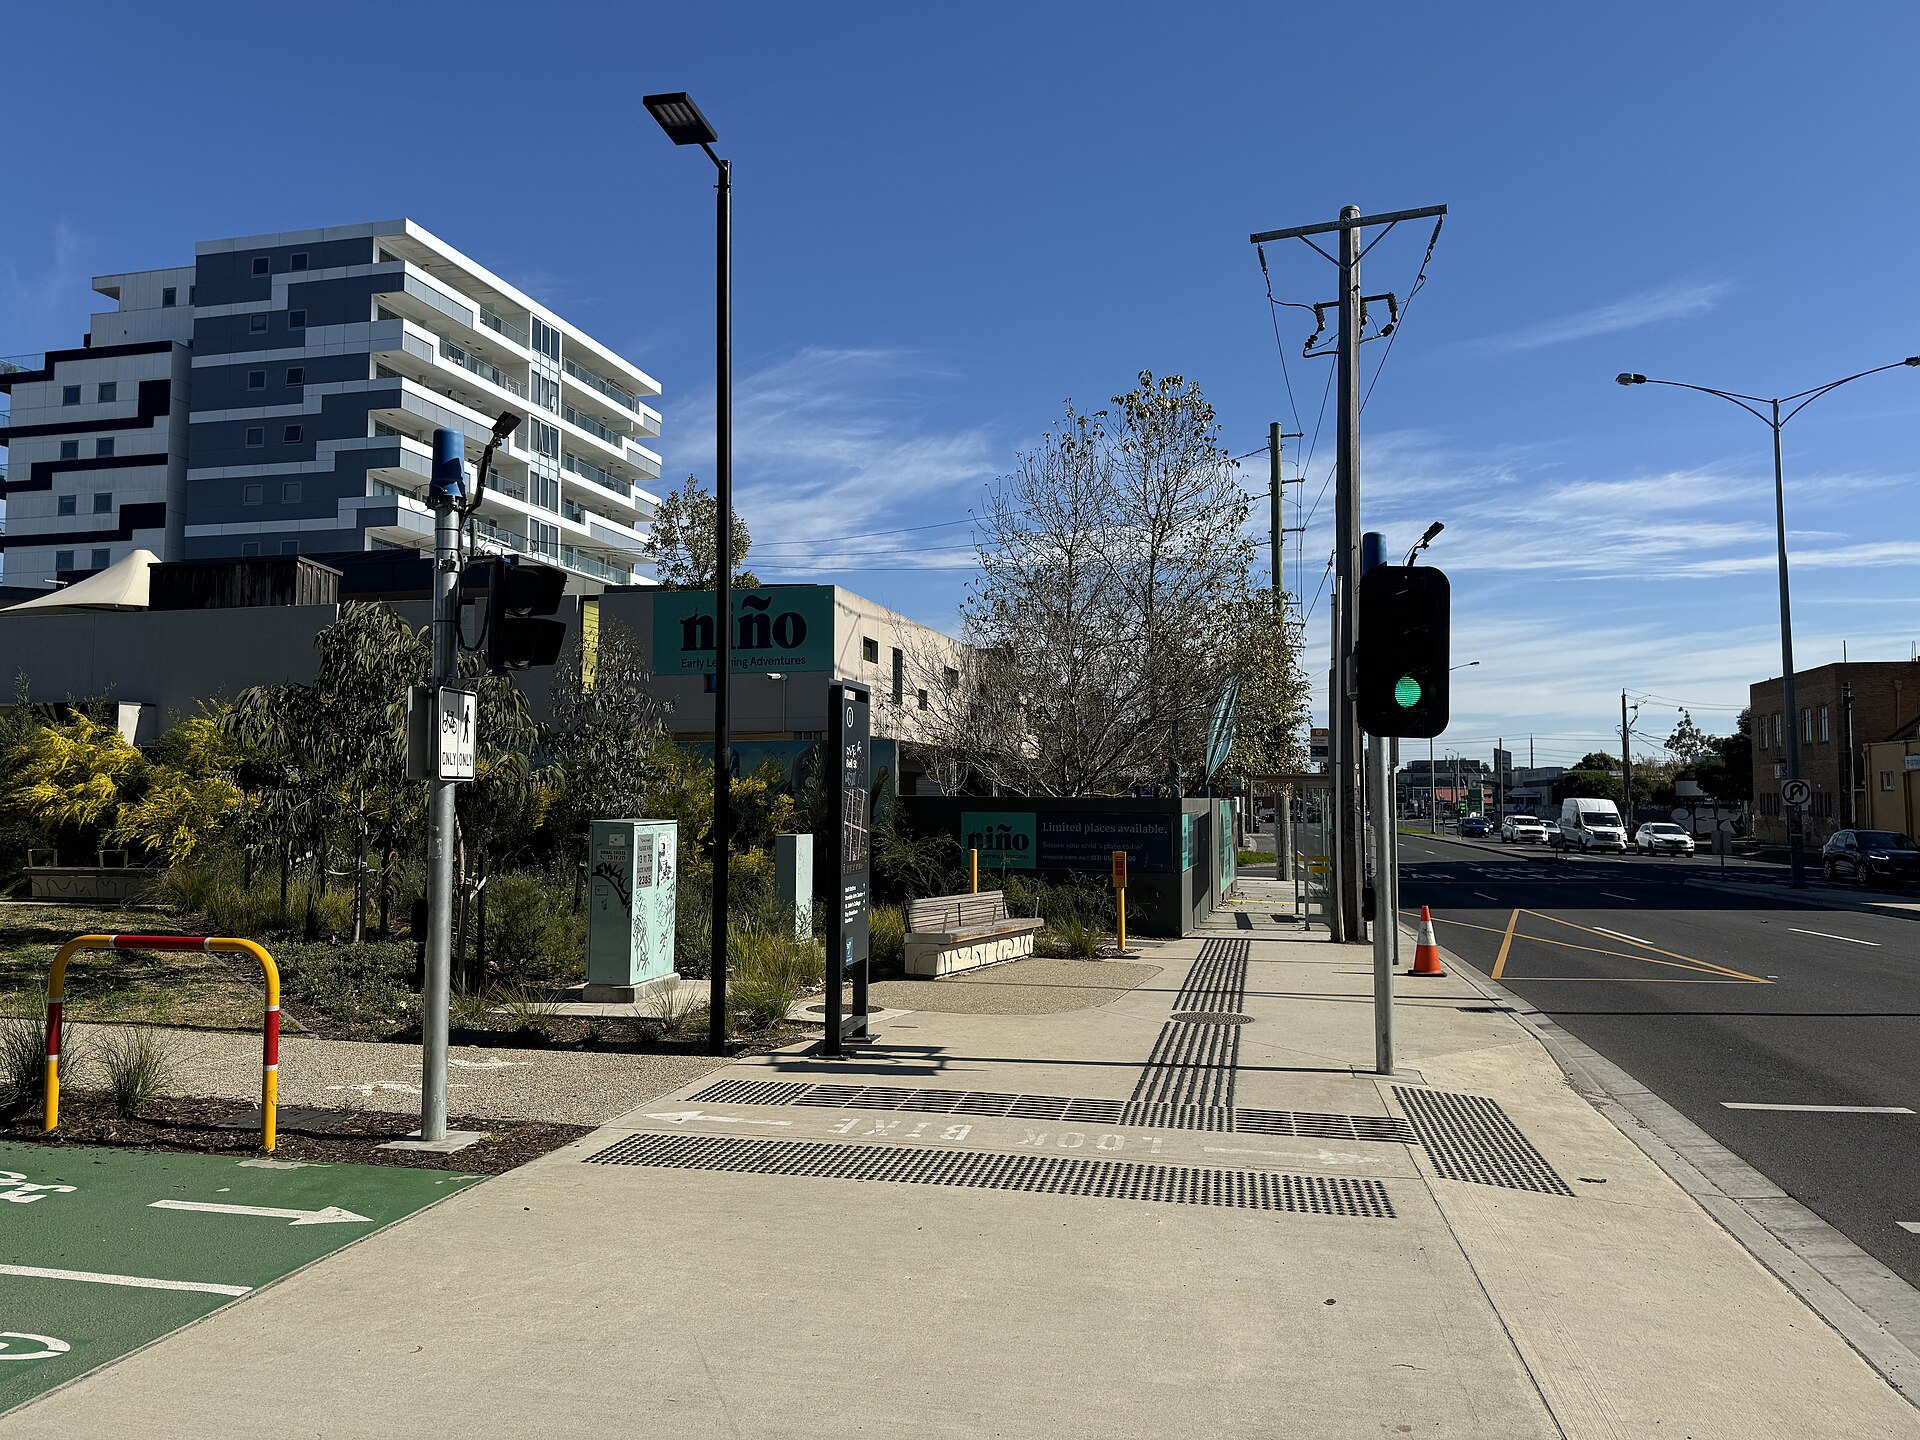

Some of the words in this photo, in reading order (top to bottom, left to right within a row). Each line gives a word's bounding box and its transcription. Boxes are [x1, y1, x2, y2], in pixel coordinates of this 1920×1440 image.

[680, 595, 807, 651] nño
[681, 658, 704, 670] Early
[750, 656, 806, 667] Adventures
[442, 752, 457, 766] ONLY
[459, 753, 472, 767] ONLY
[1042, 822, 1082, 833] Limited
[1084, 823, 1116, 835] places
[1117, 823, 1168, 835] available.
[827, 1118, 974, 1141] BIKE
[1015, 1128, 1171, 1154] LOOK
